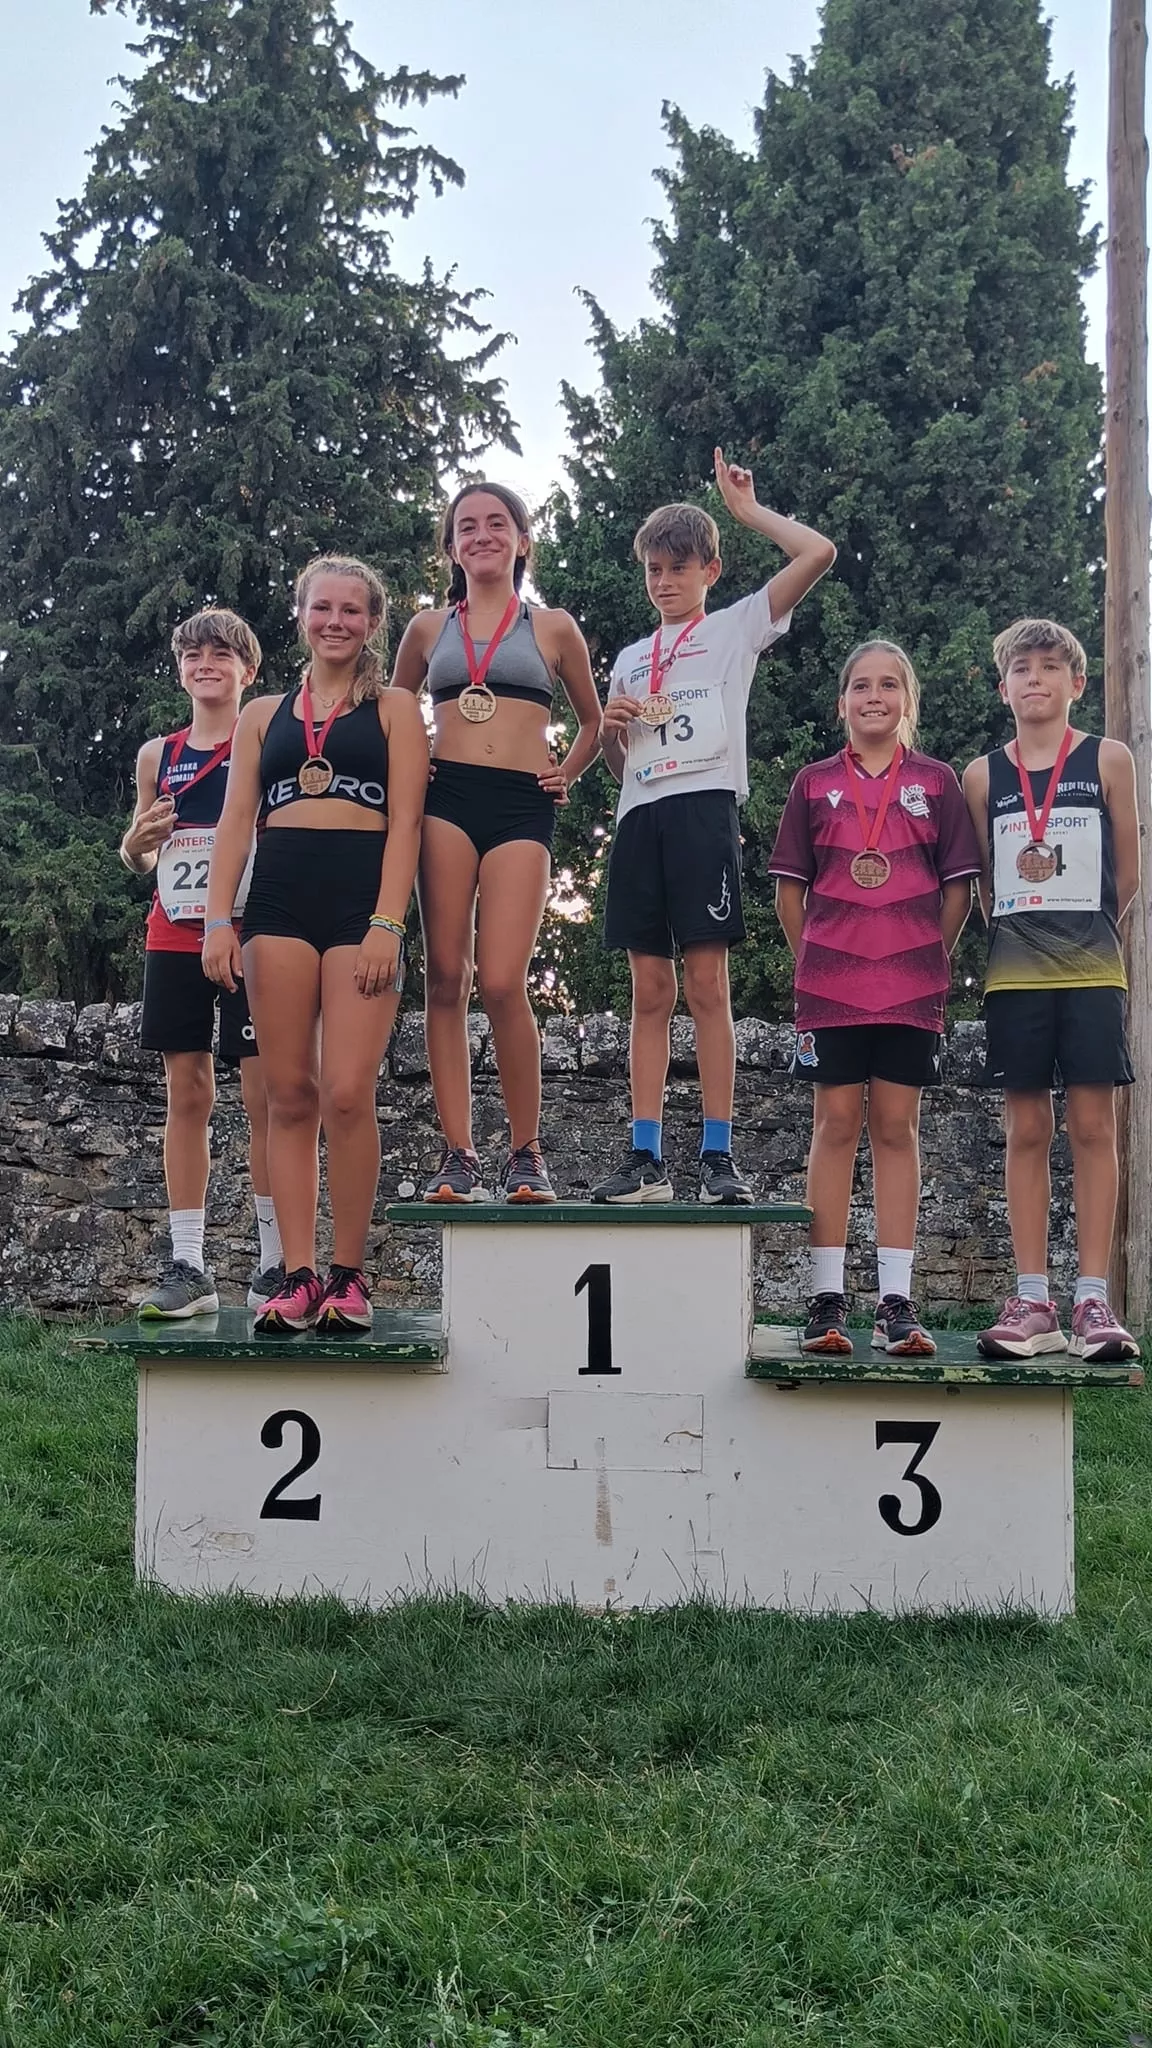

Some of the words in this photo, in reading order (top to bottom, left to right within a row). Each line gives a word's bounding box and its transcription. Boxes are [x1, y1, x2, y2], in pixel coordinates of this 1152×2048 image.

[654, 714, 693, 746] 13
[173, 835, 216, 848] INTERS
[1009, 817, 1089, 833] INTSPORT
[575, 1264, 622, 1375] 1
[260, 1409, 321, 1521] 2
[875, 1420, 942, 1536] 3
